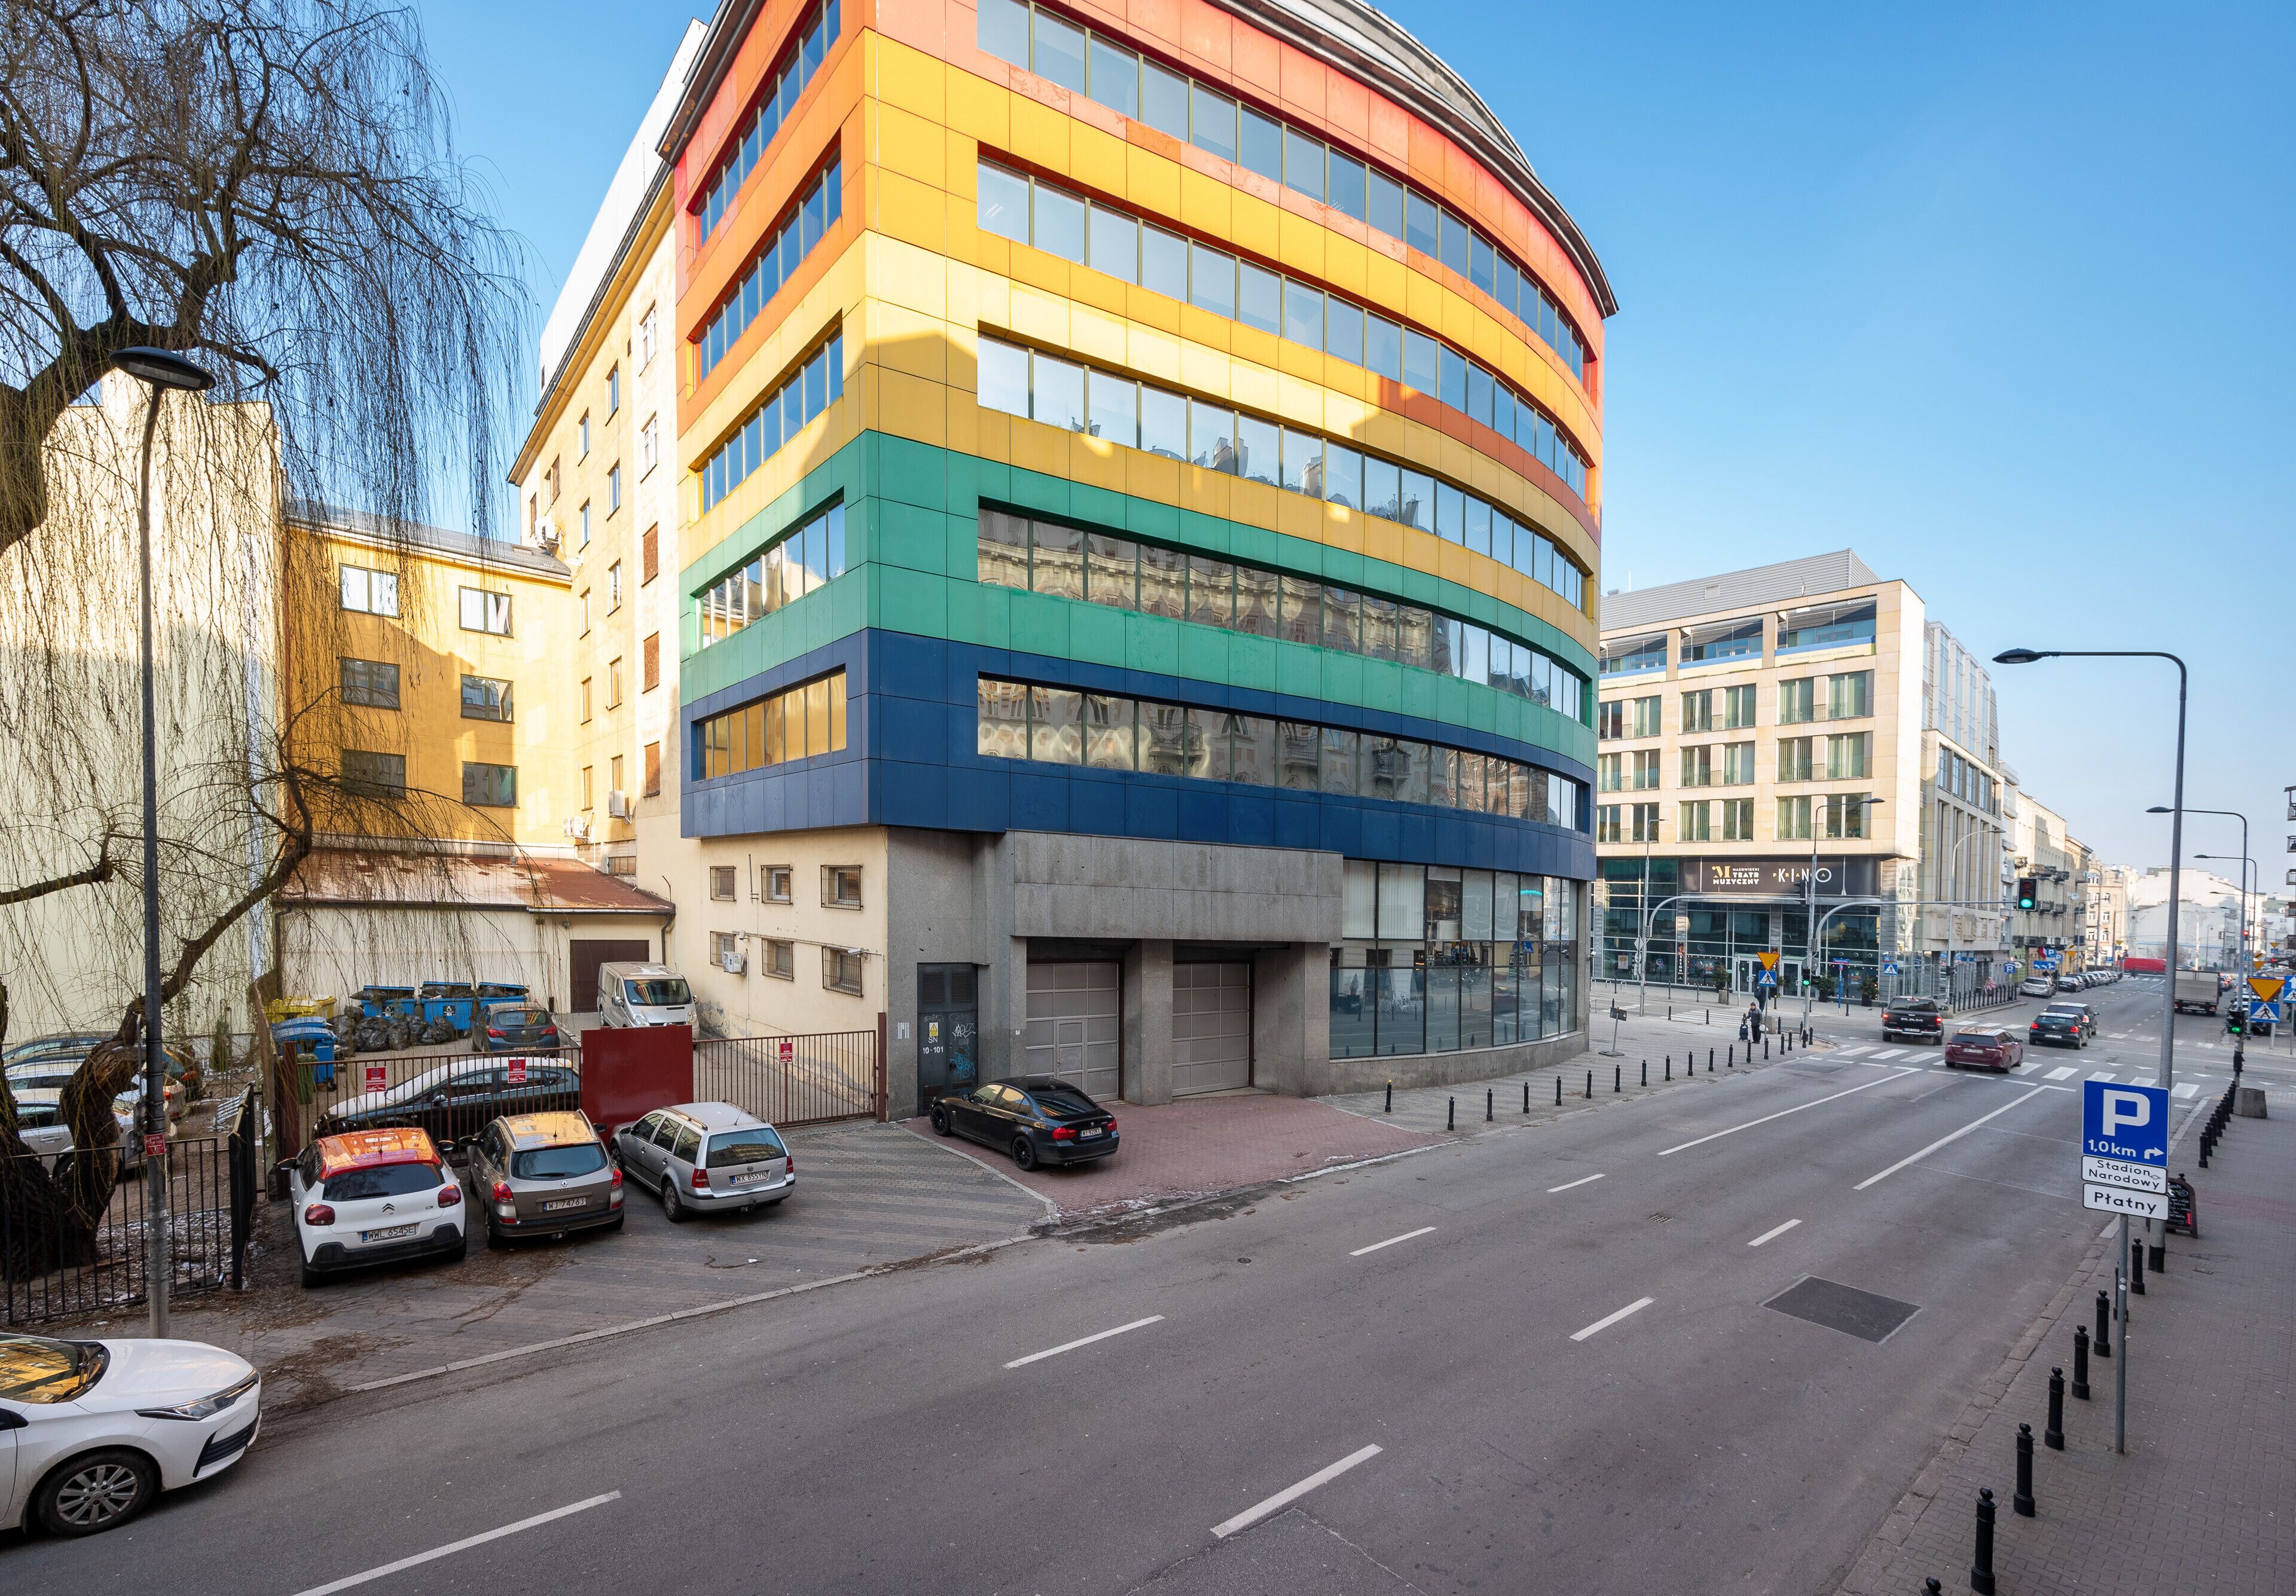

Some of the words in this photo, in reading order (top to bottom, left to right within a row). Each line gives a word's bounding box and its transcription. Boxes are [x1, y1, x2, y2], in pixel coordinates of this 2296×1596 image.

[1778, 868, 1832, 883] KINO
[2103, 1089, 2150, 1136] P
[2088, 1139, 2109, 1152] 1,0
[2111, 1142, 2136, 1157] km
[2097, 1160, 2150, 1176] Stadion
[747, 1172, 766, 1181] 855YN
[2089, 1169, 2159, 1190] Narodowy
[561, 1198, 584, 1208] 7476J
[2094, 1192, 2157, 1214] Płatny
[368, 1231, 384, 1239] WWL
[388, 1225, 414, 1236] 6545E
